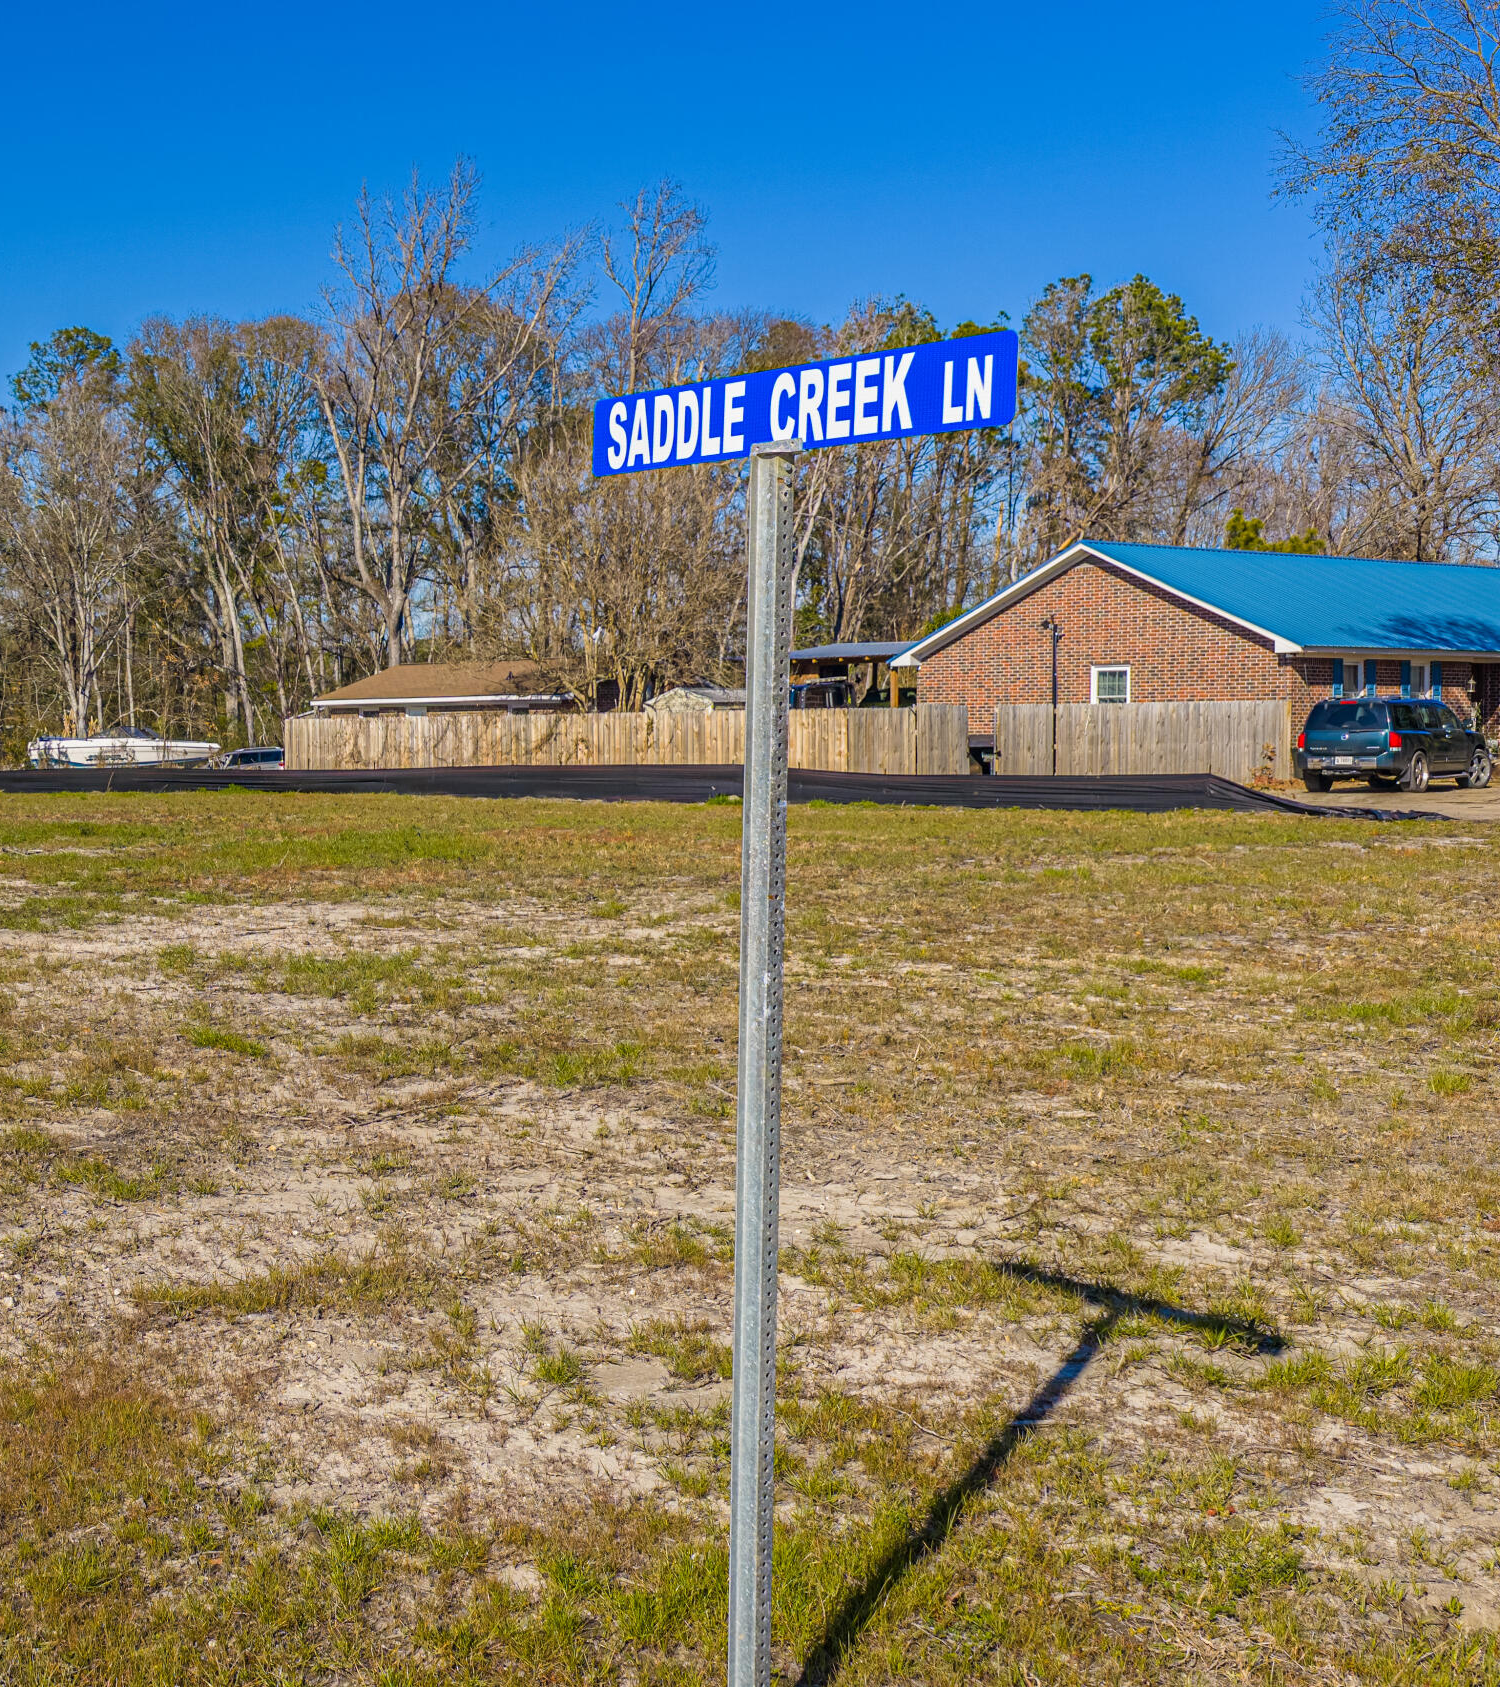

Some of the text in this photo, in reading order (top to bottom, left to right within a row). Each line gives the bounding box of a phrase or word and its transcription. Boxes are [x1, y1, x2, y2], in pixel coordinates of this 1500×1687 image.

[607, 351, 994, 470] SADDLE CREEK LN
